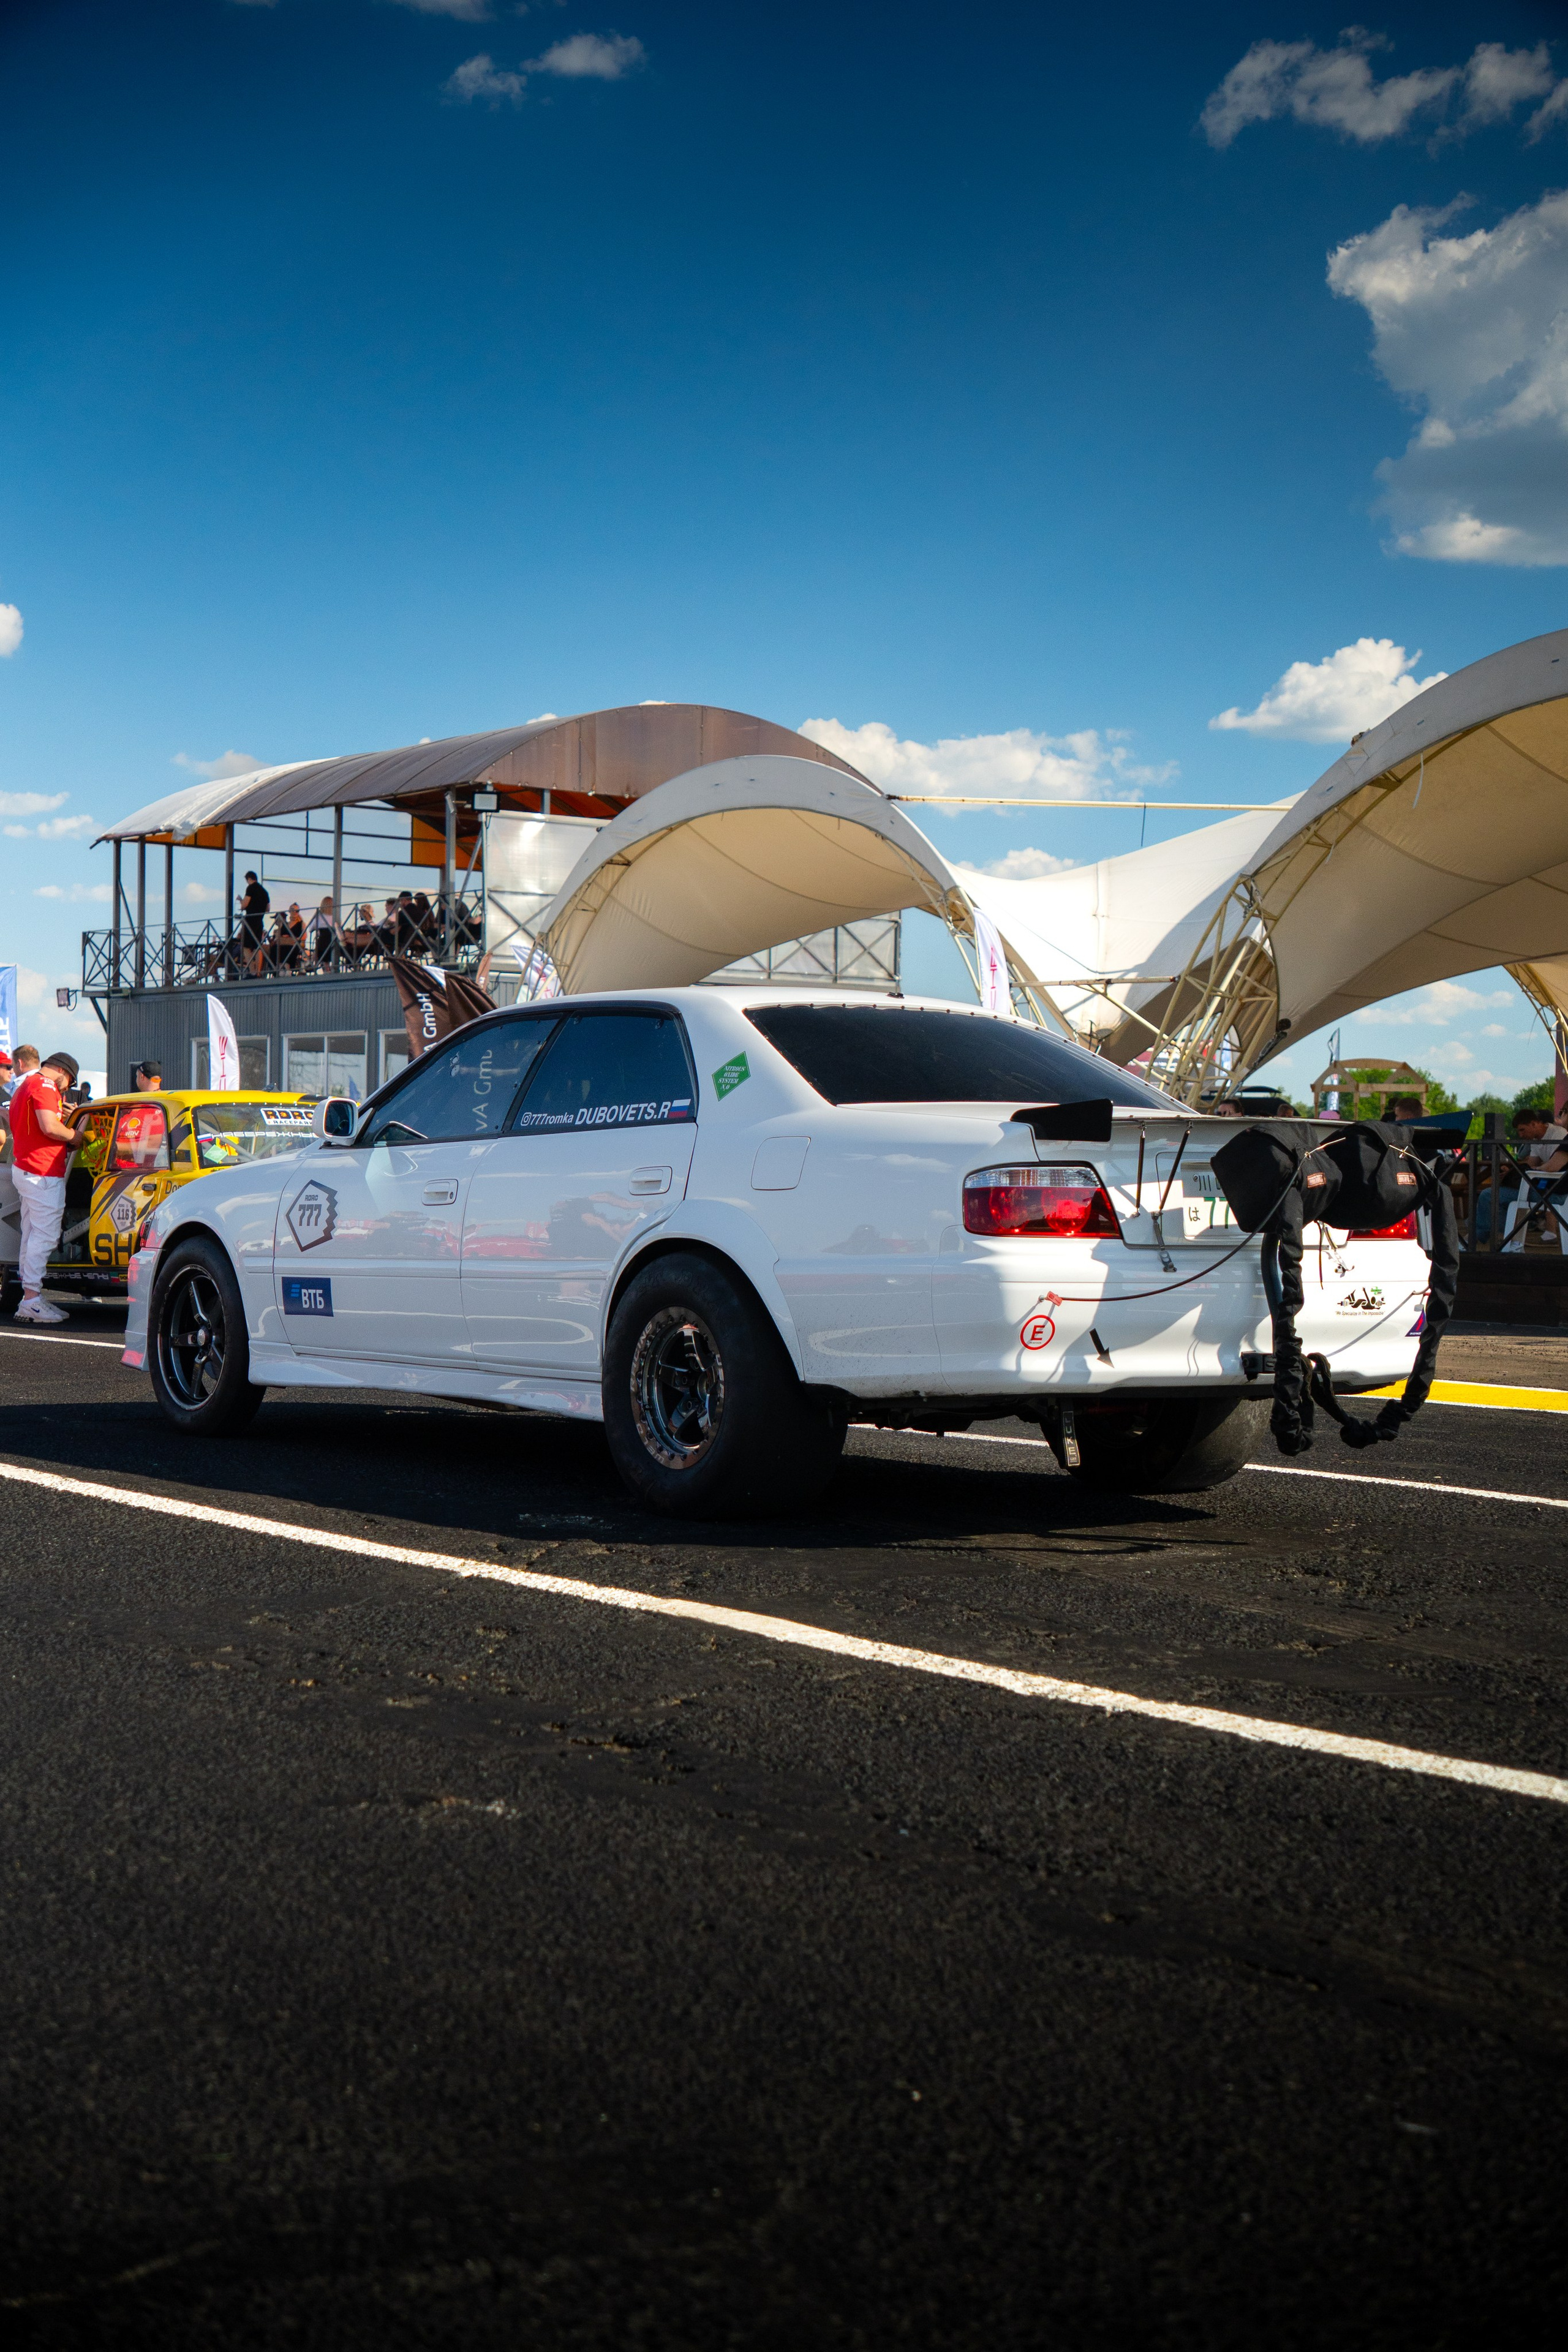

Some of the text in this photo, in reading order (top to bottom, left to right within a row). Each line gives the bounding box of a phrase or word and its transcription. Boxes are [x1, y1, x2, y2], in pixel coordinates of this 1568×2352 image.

[416, 993, 437, 1039] GmbH
[529, 1101, 671, 1125] 777romka DUBOVETS.R
[117, 1208, 129, 1220] 116
[298, 1204, 322, 1226] 777
[1189, 1207, 1200, 1221] は
[301, 1289, 325, 1309] ВТБ
[1030, 1325, 1046, 1341] E
[630, 1321, 652, 1392] RACING
[715, 1354, 725, 1399] USA
